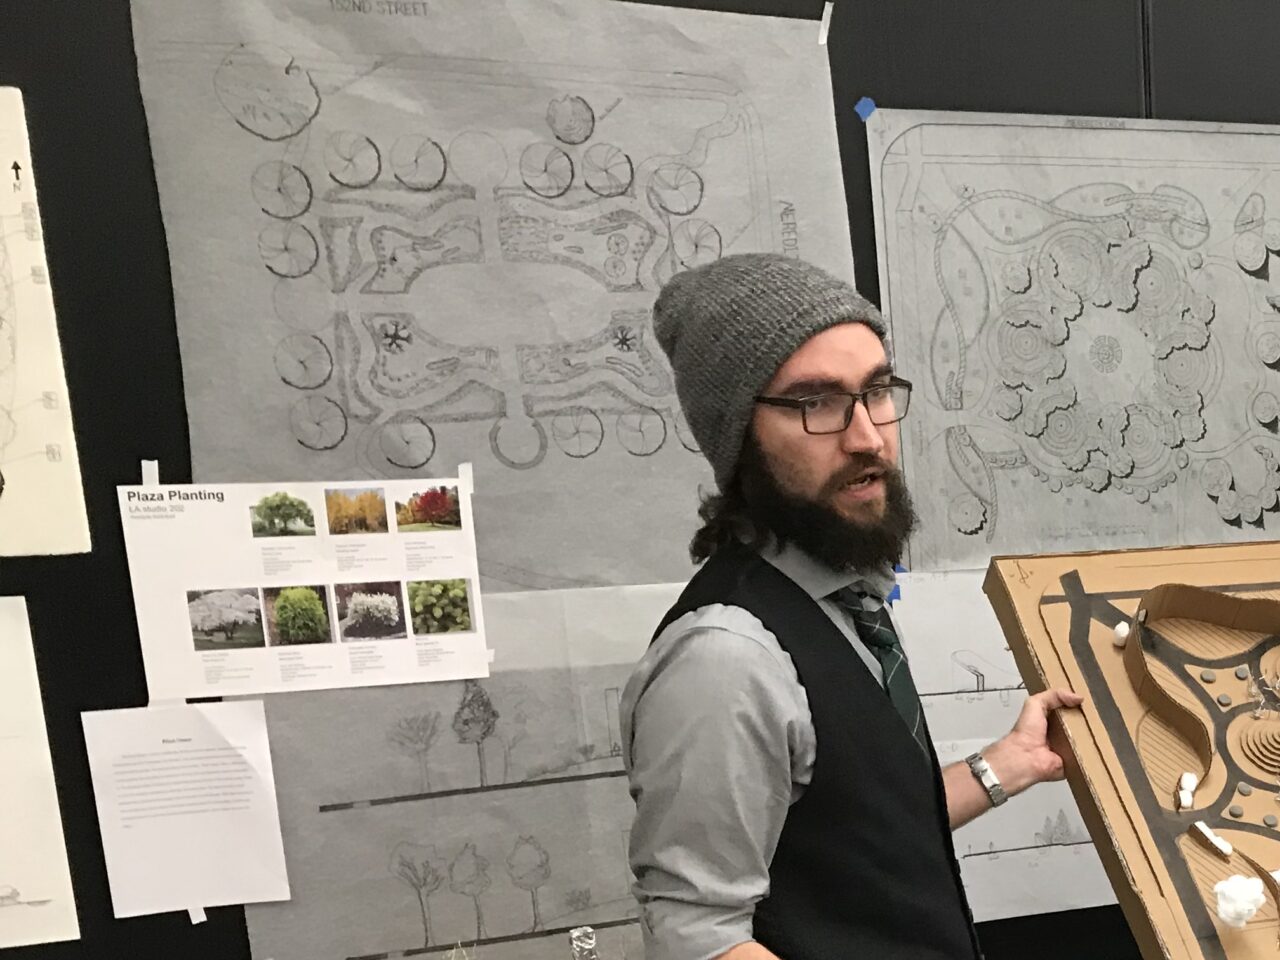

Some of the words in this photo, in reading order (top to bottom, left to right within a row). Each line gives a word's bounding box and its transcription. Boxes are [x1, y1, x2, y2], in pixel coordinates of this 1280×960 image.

[376, 1, 428, 16] STREET
[127, 491, 164, 502] Plaza
[168, 489, 225, 503] Planting
